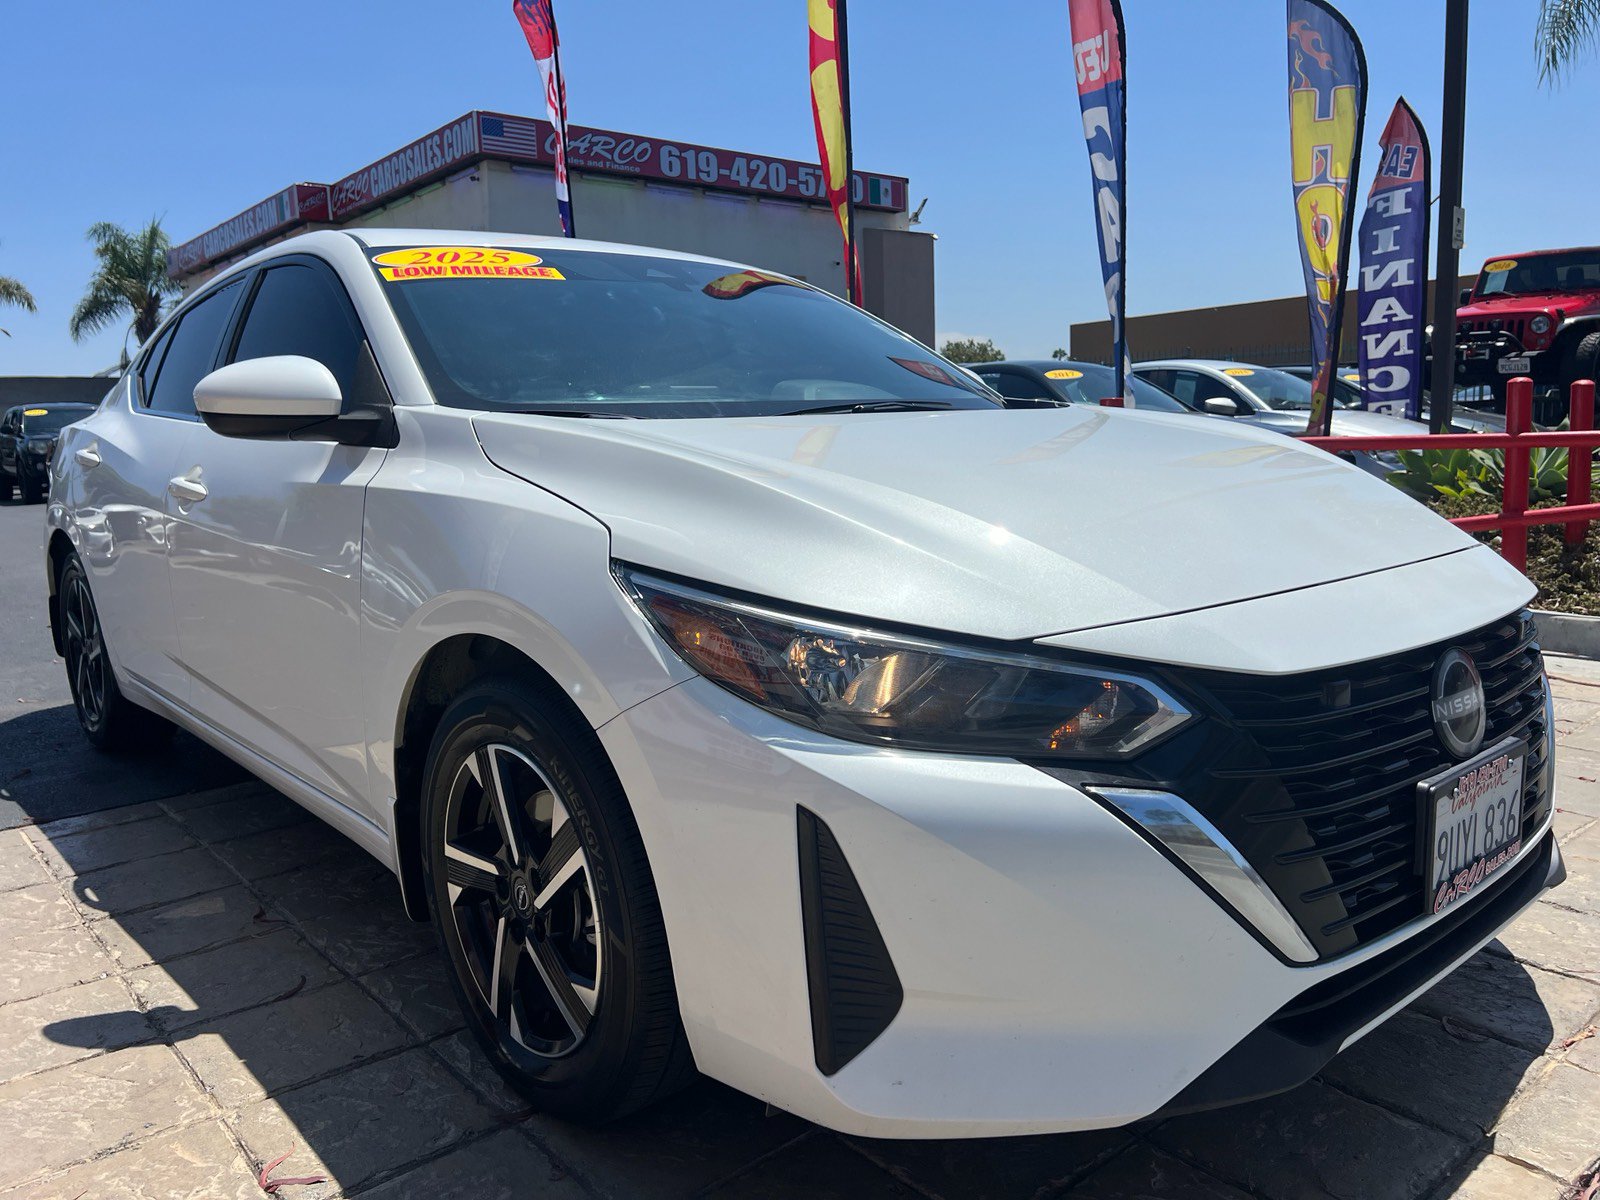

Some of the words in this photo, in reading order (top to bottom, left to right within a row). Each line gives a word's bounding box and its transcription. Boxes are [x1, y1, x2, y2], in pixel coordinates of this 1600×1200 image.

[370, 118, 475, 198] CARCOSALES.COM
[587, 160, 604, 168] and
[606, 162, 641, 173] Finance
[659, 145, 864, 203] 619-420-570
[392, 266, 448, 279] LOW
[451, 265, 553, 278] MILEAGE
[410, 251, 511, 265] 2025
[1437, 789, 1519, 885] 9UYL836
